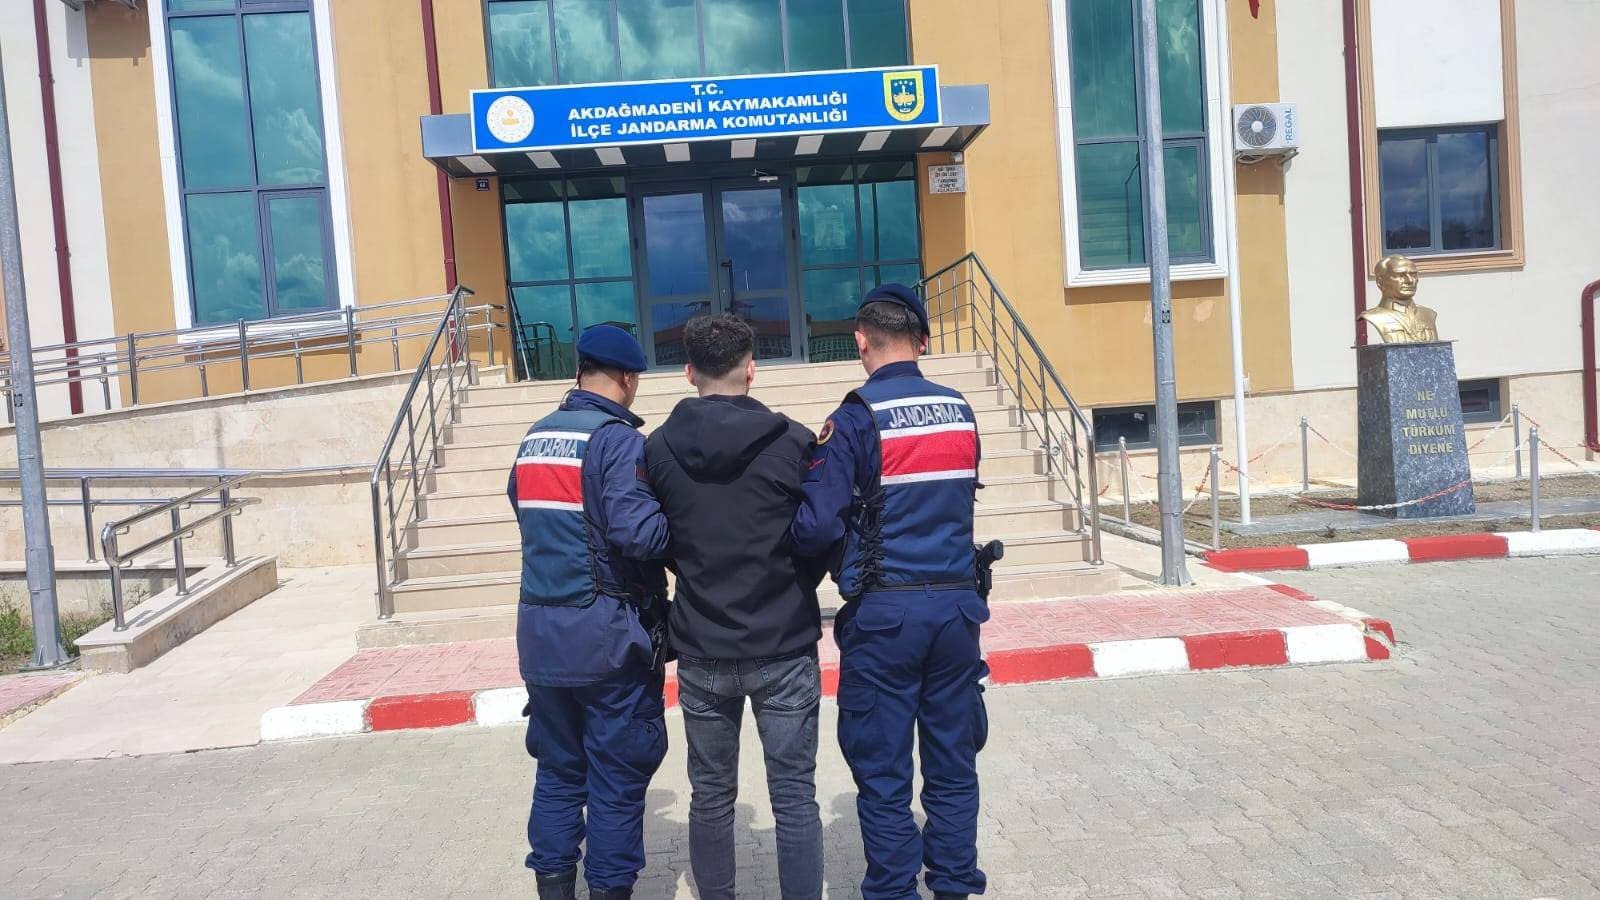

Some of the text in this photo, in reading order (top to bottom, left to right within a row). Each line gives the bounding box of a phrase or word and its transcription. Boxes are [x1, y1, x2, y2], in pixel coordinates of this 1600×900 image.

[690, 83, 724, 96] T.C.
[567, 90, 848, 120] AKDAĞMADENİ KAYMAKAMLIĞI
[570, 108, 848, 139] İLÇE JANDARMA KOMUTANLIĞI
[1284, 108, 1293, 141] REGAL
[1416, 390, 1434, 401] NE
[888, 404, 966, 428] JANDARMA
[1405, 407, 1448, 420] MUTLU
[521, 438, 578, 457] JANDARMA
